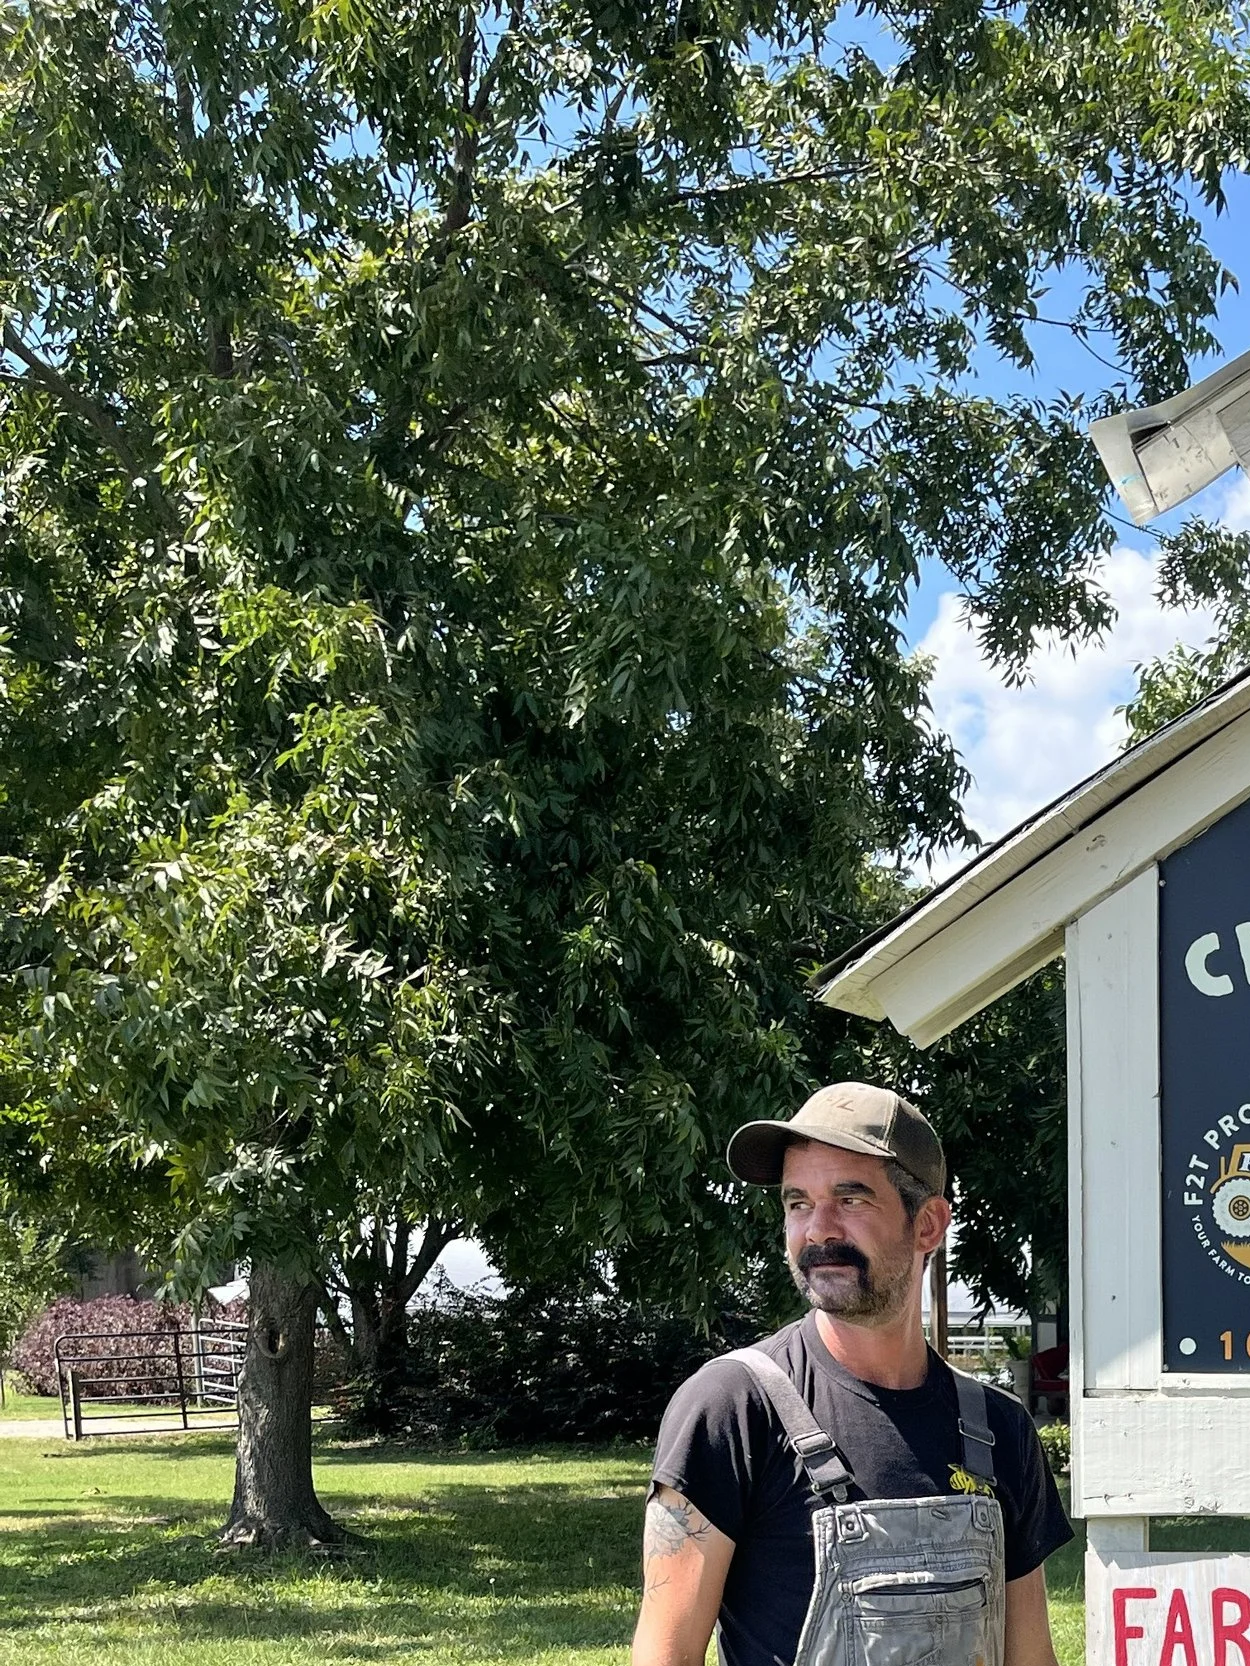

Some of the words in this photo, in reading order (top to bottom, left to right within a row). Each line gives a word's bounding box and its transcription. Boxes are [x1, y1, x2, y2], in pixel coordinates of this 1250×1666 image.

[1184, 1154, 1210, 1206] F2T
[1191, 1214, 1211, 1249] YOUR
[1207, 1248, 1236, 1277] FARM
